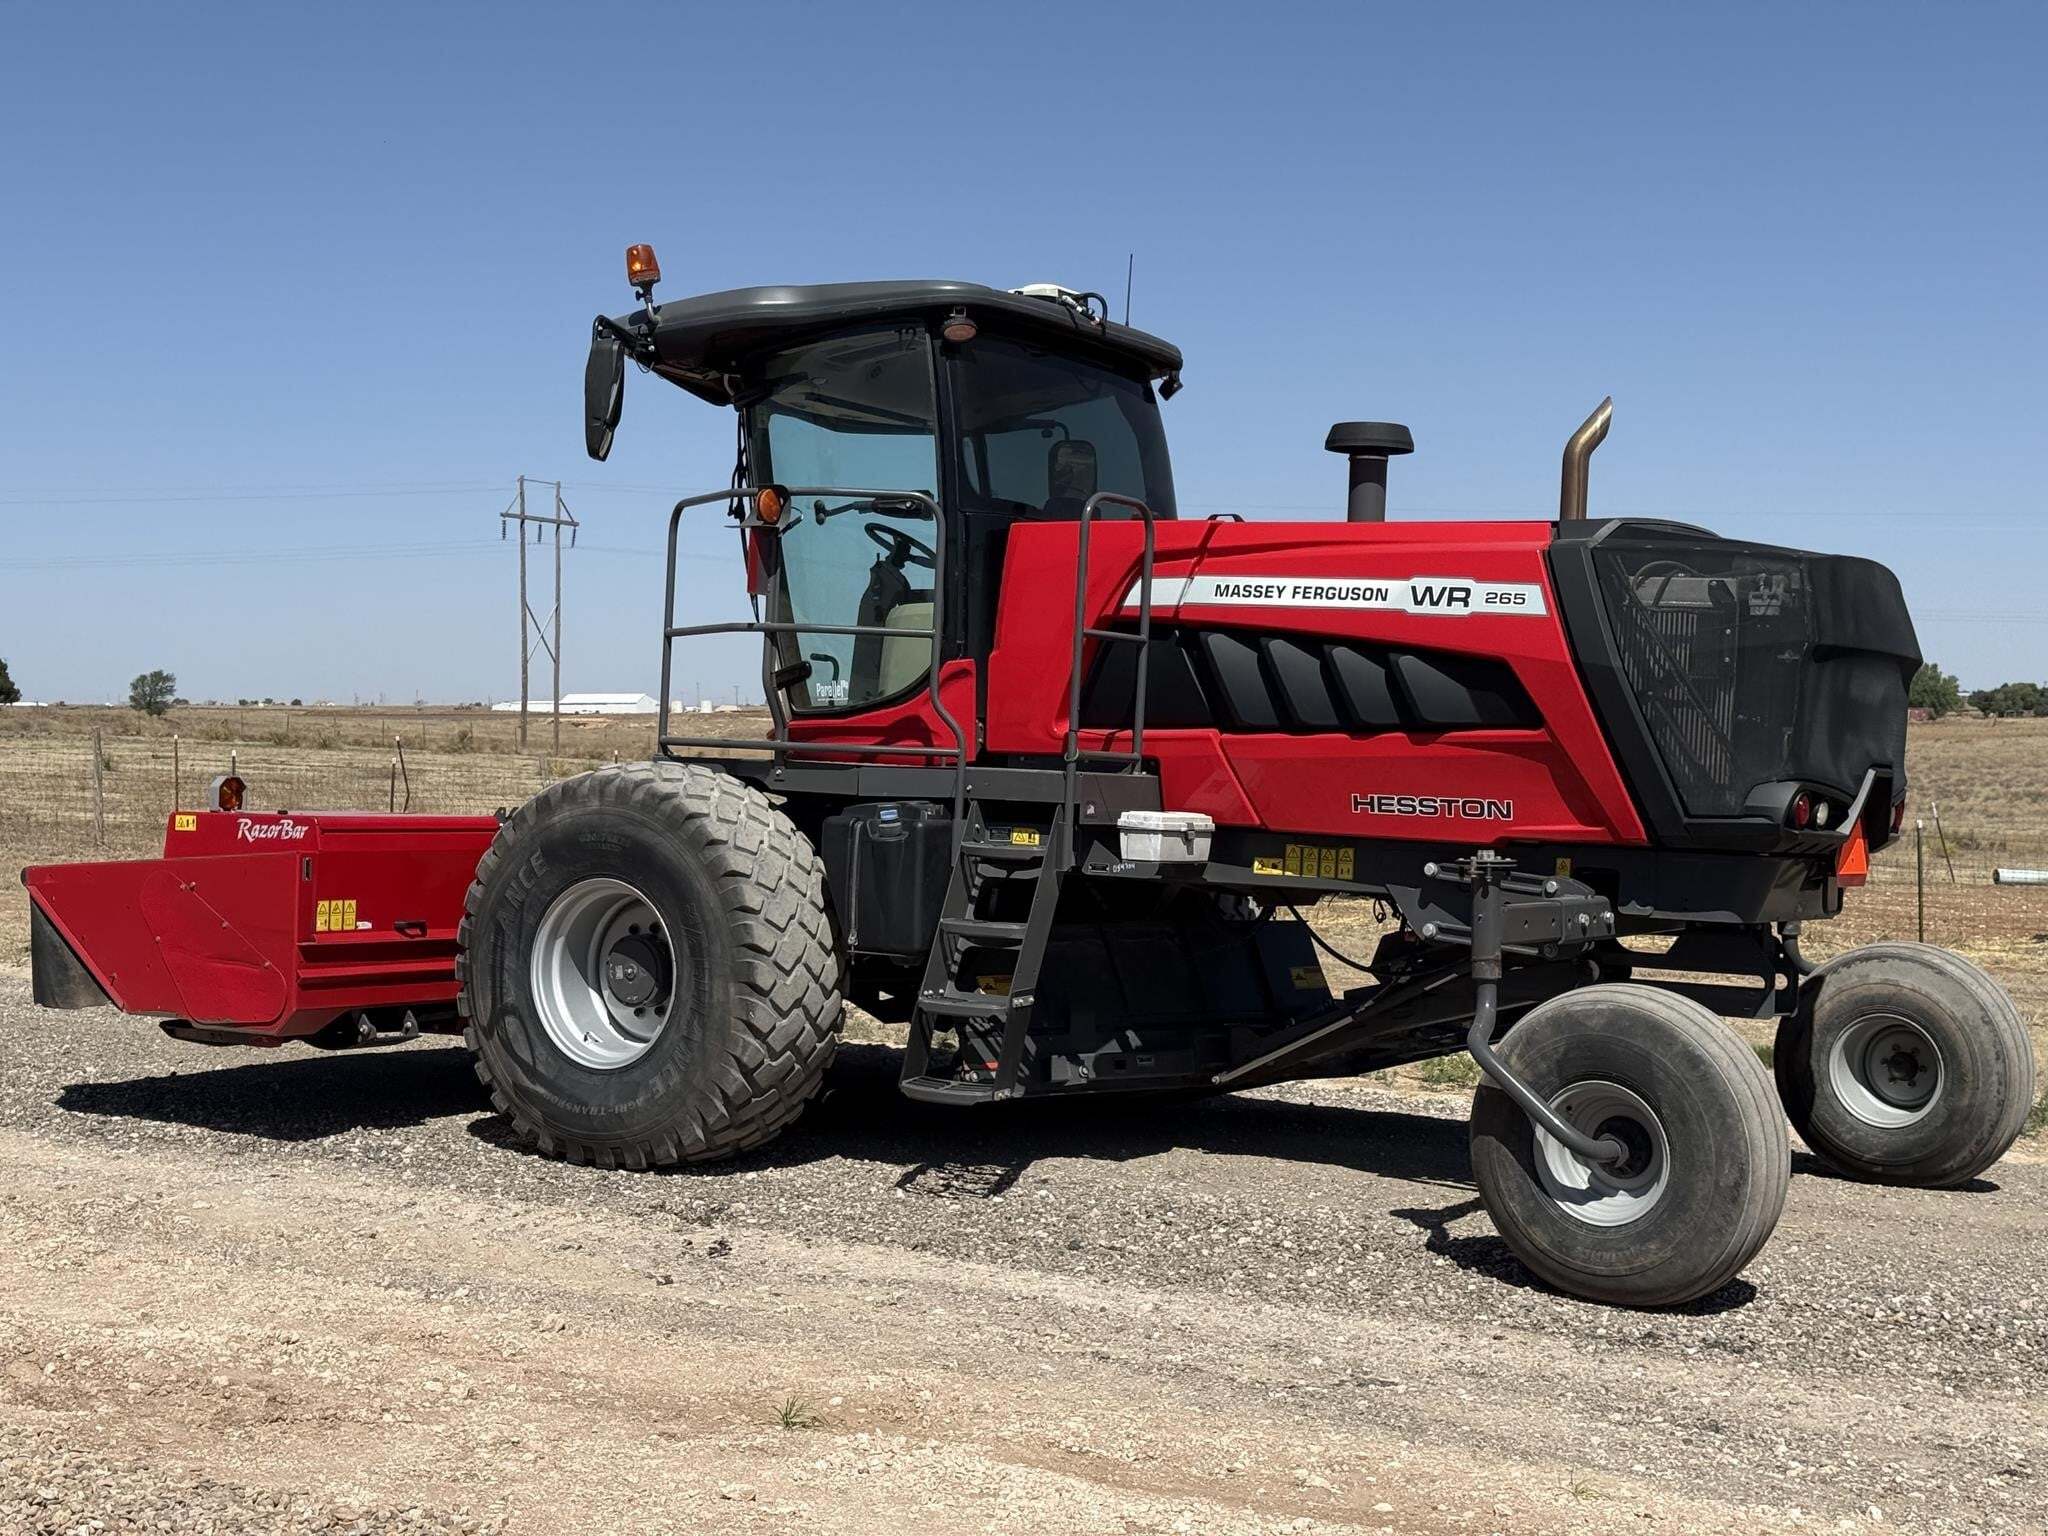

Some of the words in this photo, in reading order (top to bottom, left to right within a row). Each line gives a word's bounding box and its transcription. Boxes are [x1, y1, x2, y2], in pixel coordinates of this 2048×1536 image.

[1214, 584, 1287, 599] MASSEY
[1291, 586, 1389, 602] FERGUSON
[1410, 585, 1471, 607] WR
[1484, 591, 1526, 605] 265
[1351, 793, 1513, 821] HESSTON
[236, 818, 309, 843] RazorBar
